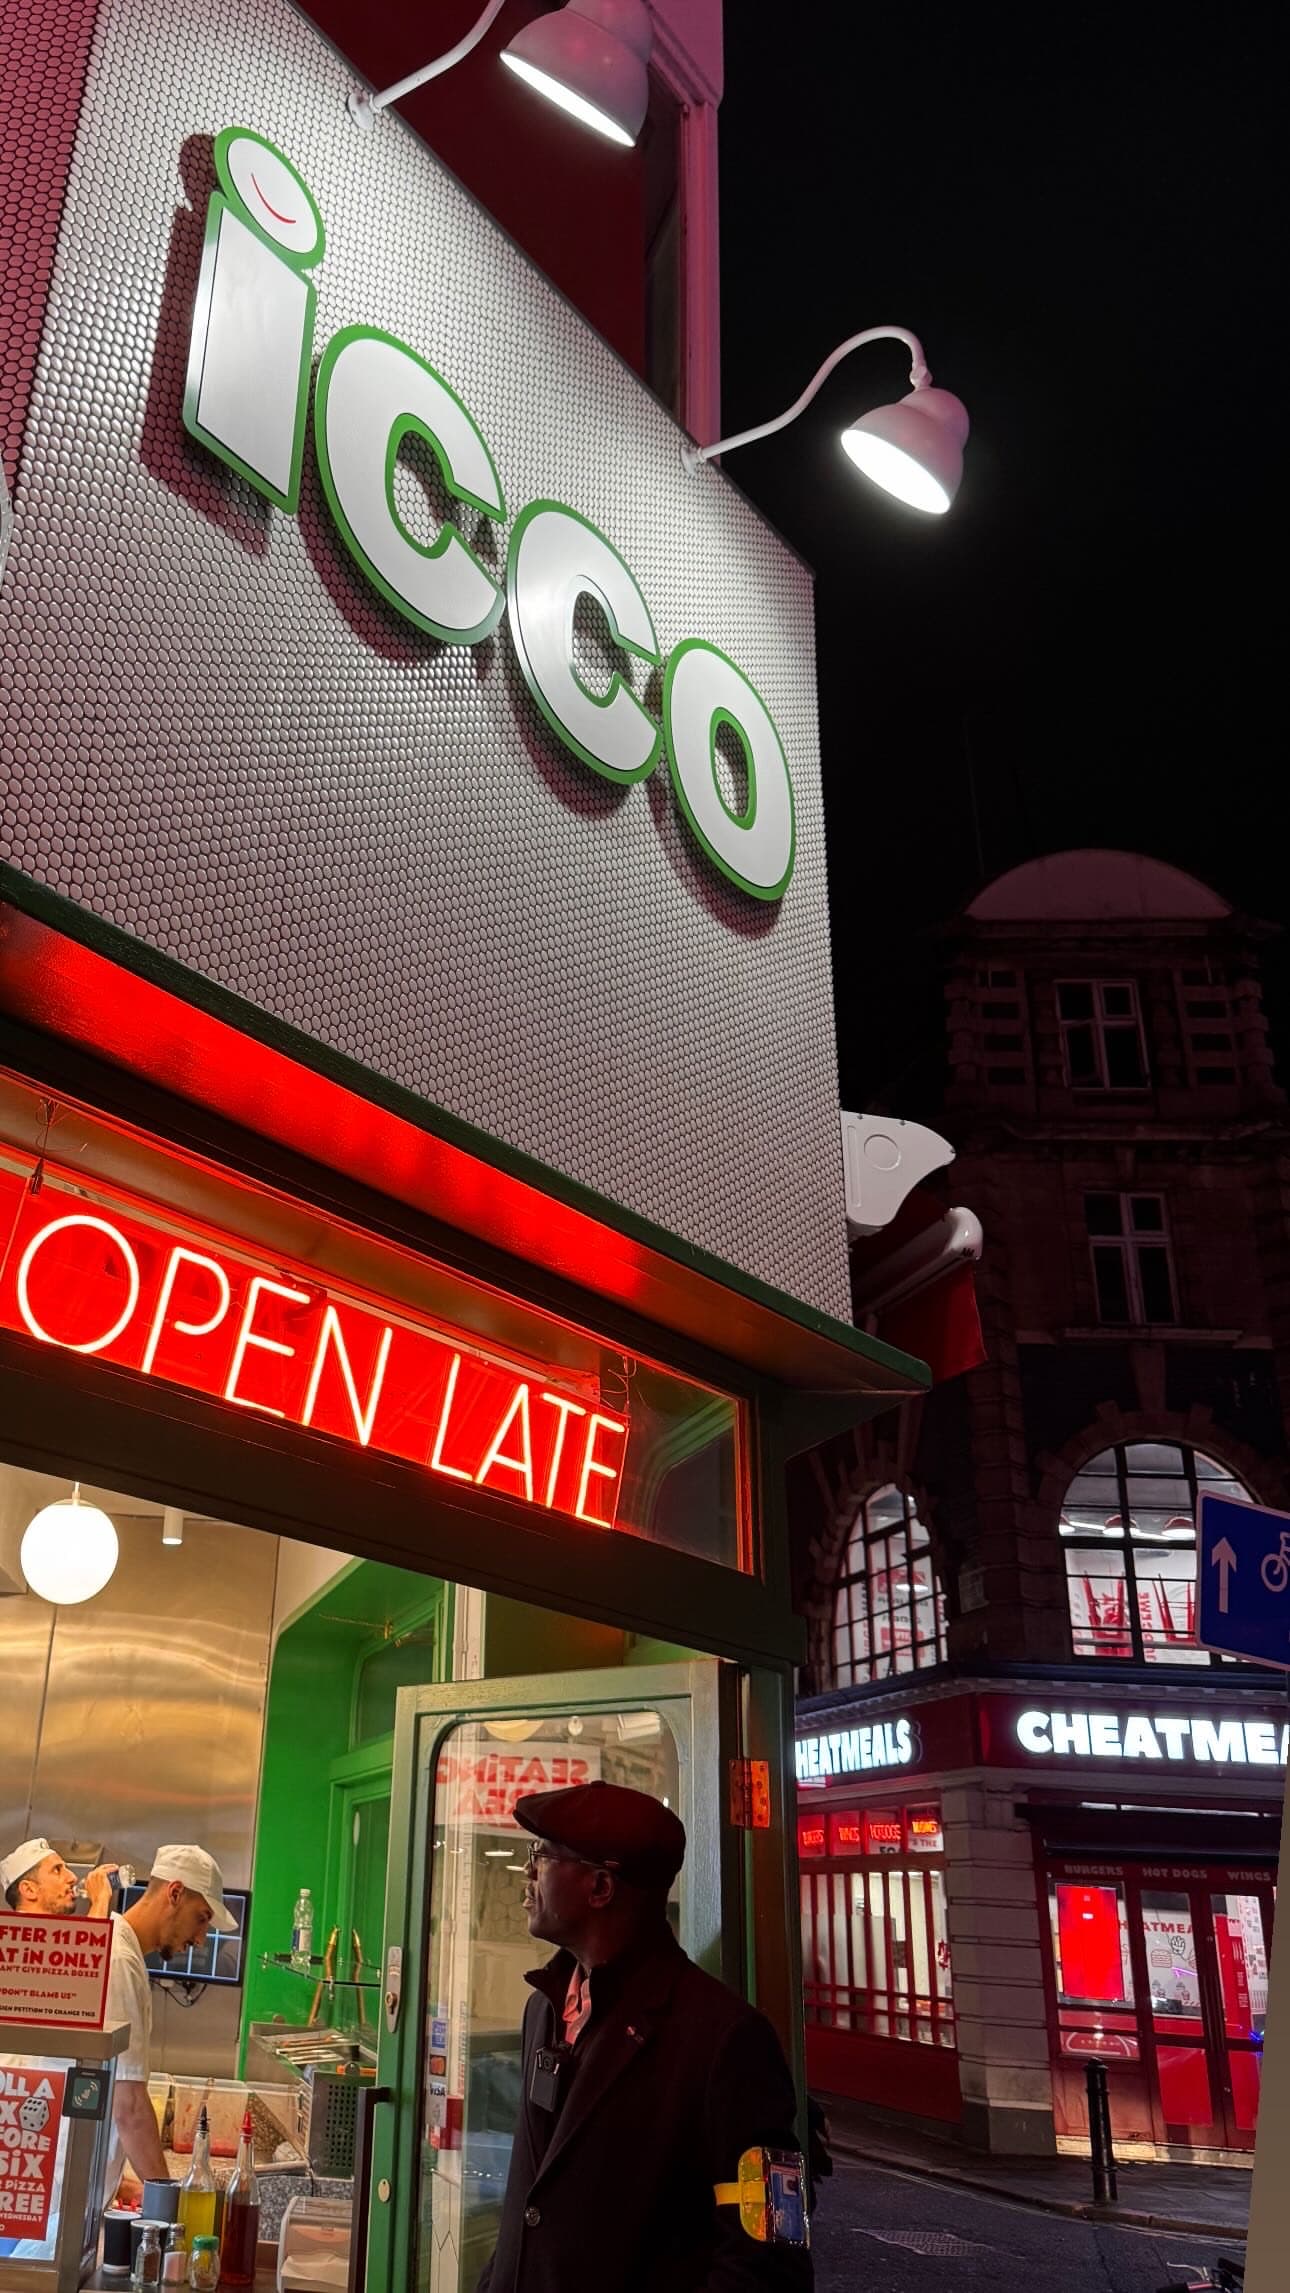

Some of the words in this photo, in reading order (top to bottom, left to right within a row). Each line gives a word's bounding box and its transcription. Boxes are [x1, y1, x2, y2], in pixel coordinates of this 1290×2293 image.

[16, 1214, 393, 1447] OPEN
[430, 1352, 626, 1529] LATE
[1064, 1864, 1124, 1876] BURGERS
[1142, 1867, 1168, 1878] HOT
[1172, 1868, 1208, 1879] DOGS
[1227, 1871, 1271, 1881] WINGS
[52, 1929, 71, 1945] 11
[75, 1931, 107, 1948] PM
[48, 1951, 103, 1969] ONLY
